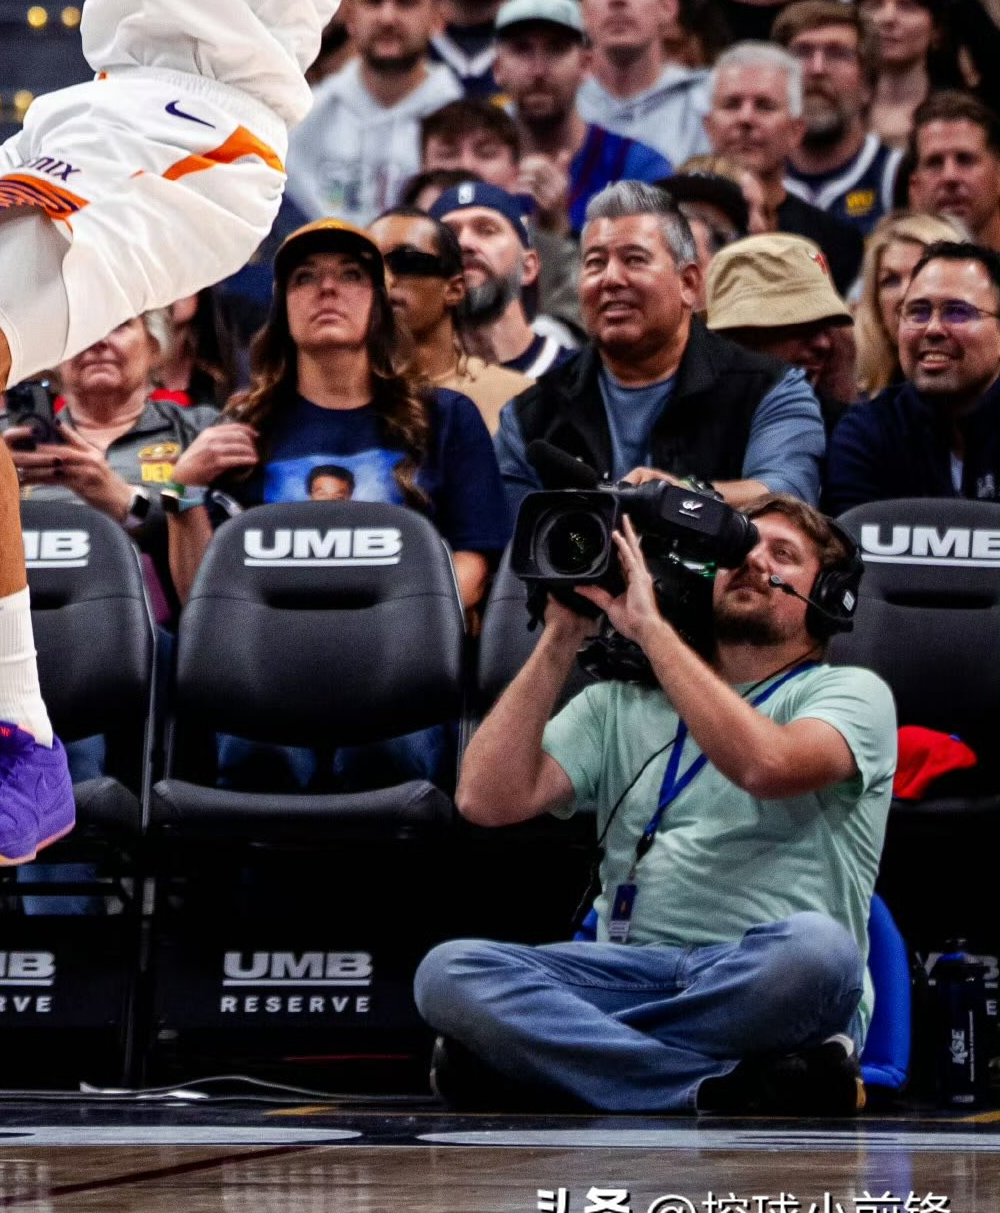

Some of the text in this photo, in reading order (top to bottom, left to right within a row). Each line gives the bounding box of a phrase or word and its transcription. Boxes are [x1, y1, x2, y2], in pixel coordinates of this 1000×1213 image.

[244, 528, 402, 559] UMB
[223, 951, 373, 980] UMB
[220, 995, 371, 1013] RESERVE
